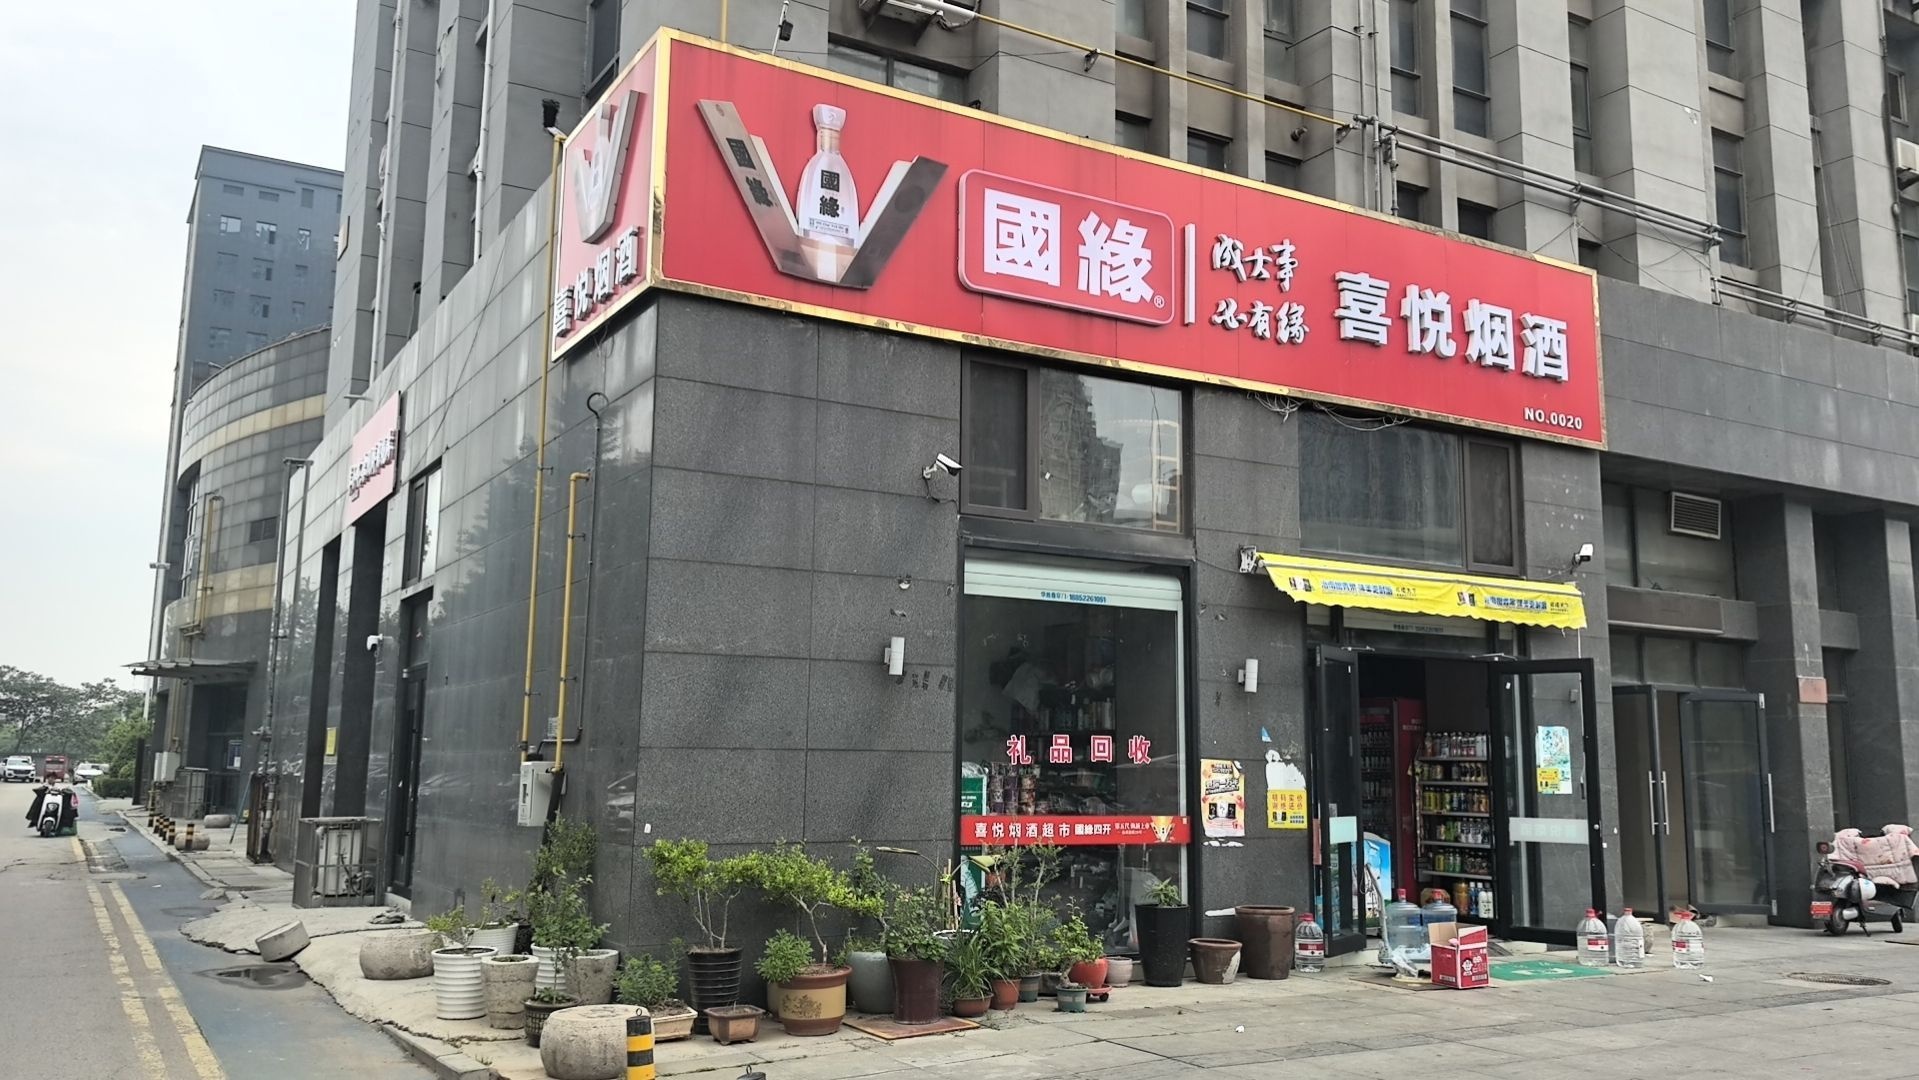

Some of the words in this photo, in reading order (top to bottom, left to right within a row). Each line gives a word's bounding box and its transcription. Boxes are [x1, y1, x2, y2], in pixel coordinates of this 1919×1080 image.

[553, 226, 639, 337] 喜悦烟酒
[1334, 270, 1569, 382] 喜悦烟酒
[1524, 407, 1583, 430] NO.0020
[1007, 735, 1151, 764] 礼品回收
[975, 822, 1071, 838] 喜悦烟酒超市
